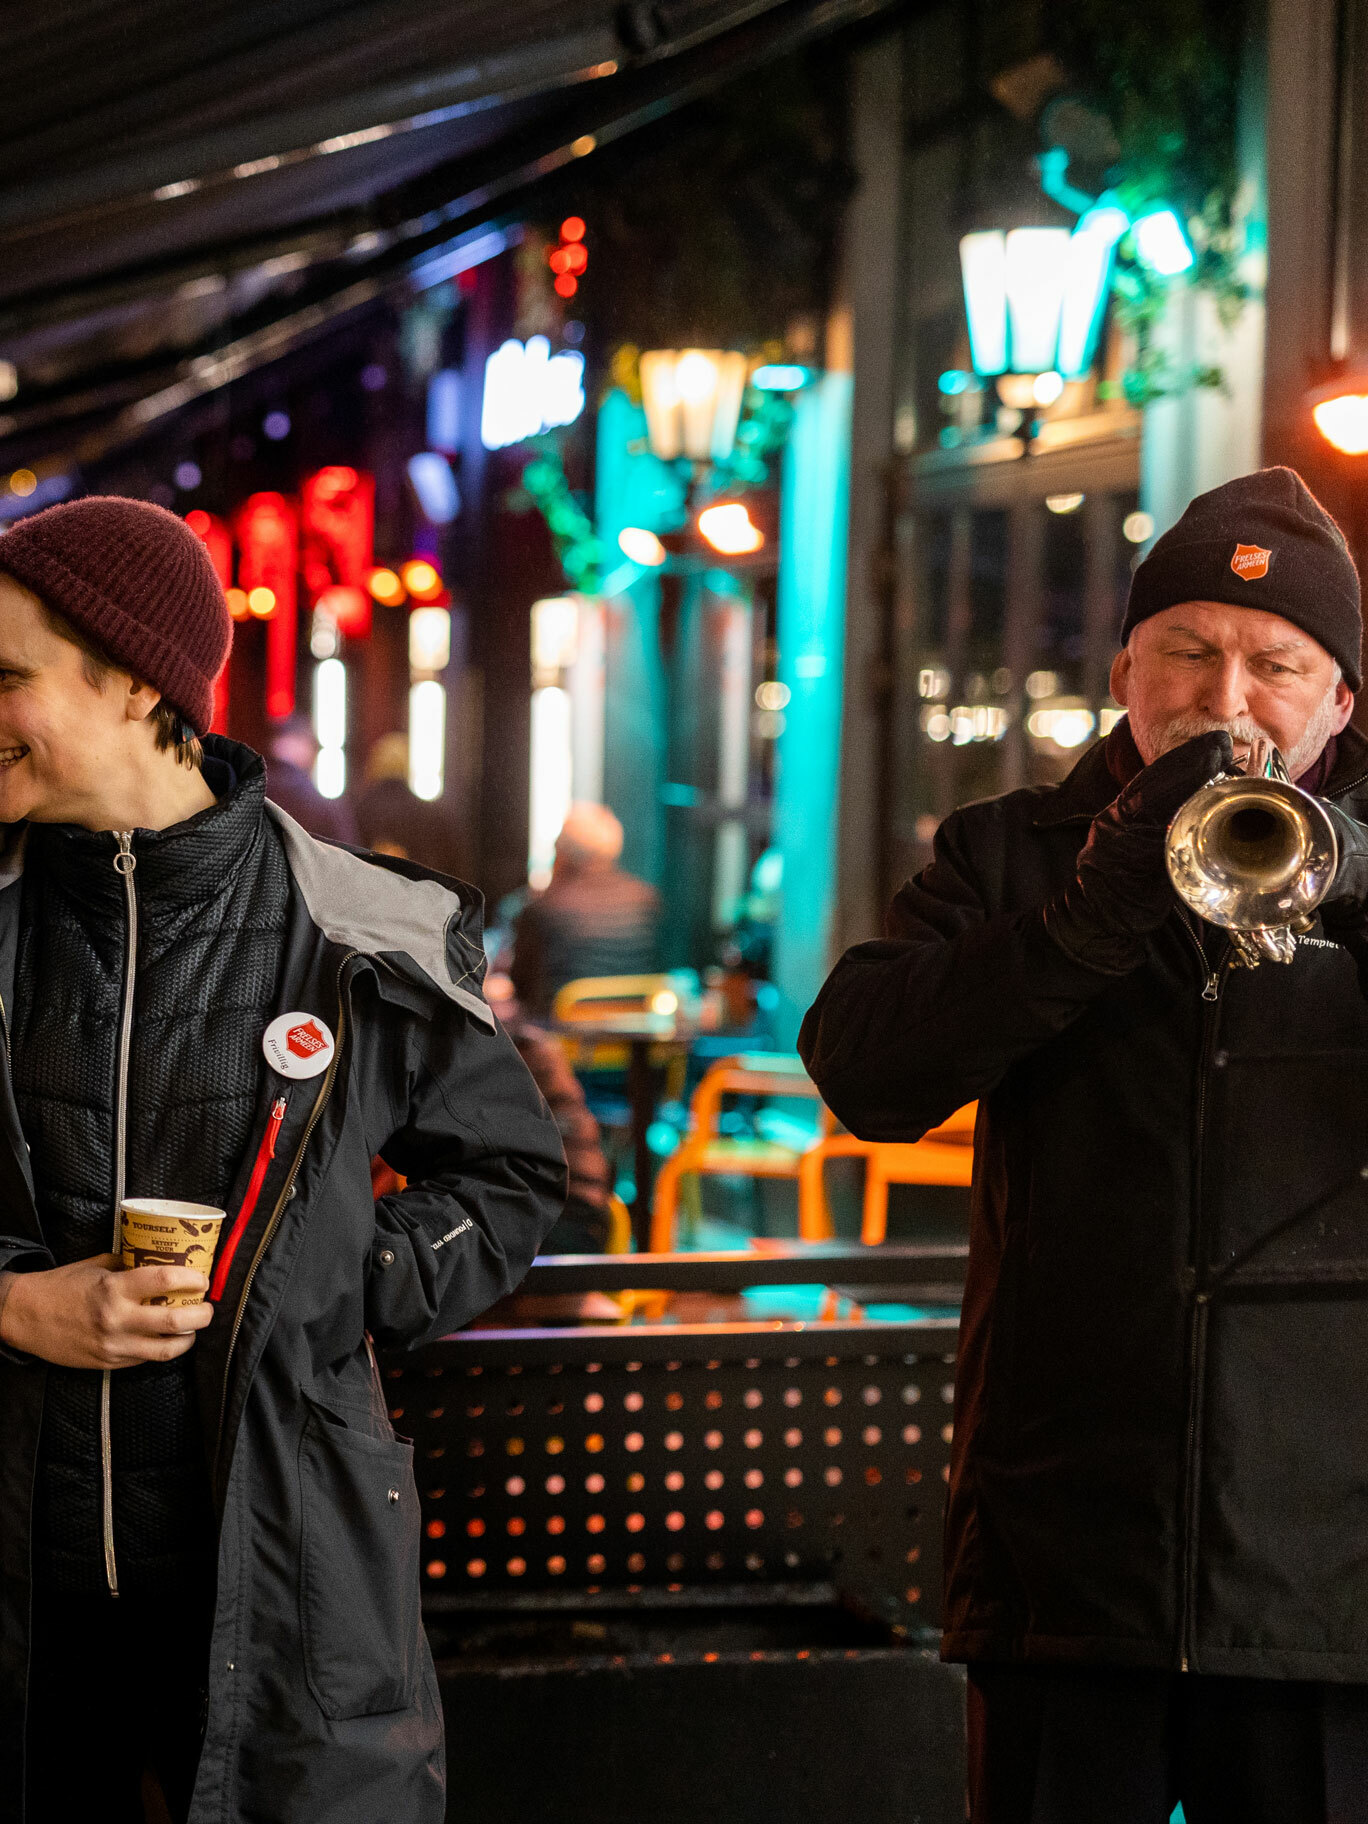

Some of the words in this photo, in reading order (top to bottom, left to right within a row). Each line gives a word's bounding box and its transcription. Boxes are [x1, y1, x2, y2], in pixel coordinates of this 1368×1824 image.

[1234, 552, 1267, 564] FRELSES
[1236, 559, 1265, 571] ARMEEN
[288, 1035, 314, 1052] ARMEEN
[293, 1028, 325, 1049] FRELSES
[268, 1039, 289, 1070] Frivillig
[132, 1222, 177, 1233] YOURSELF
